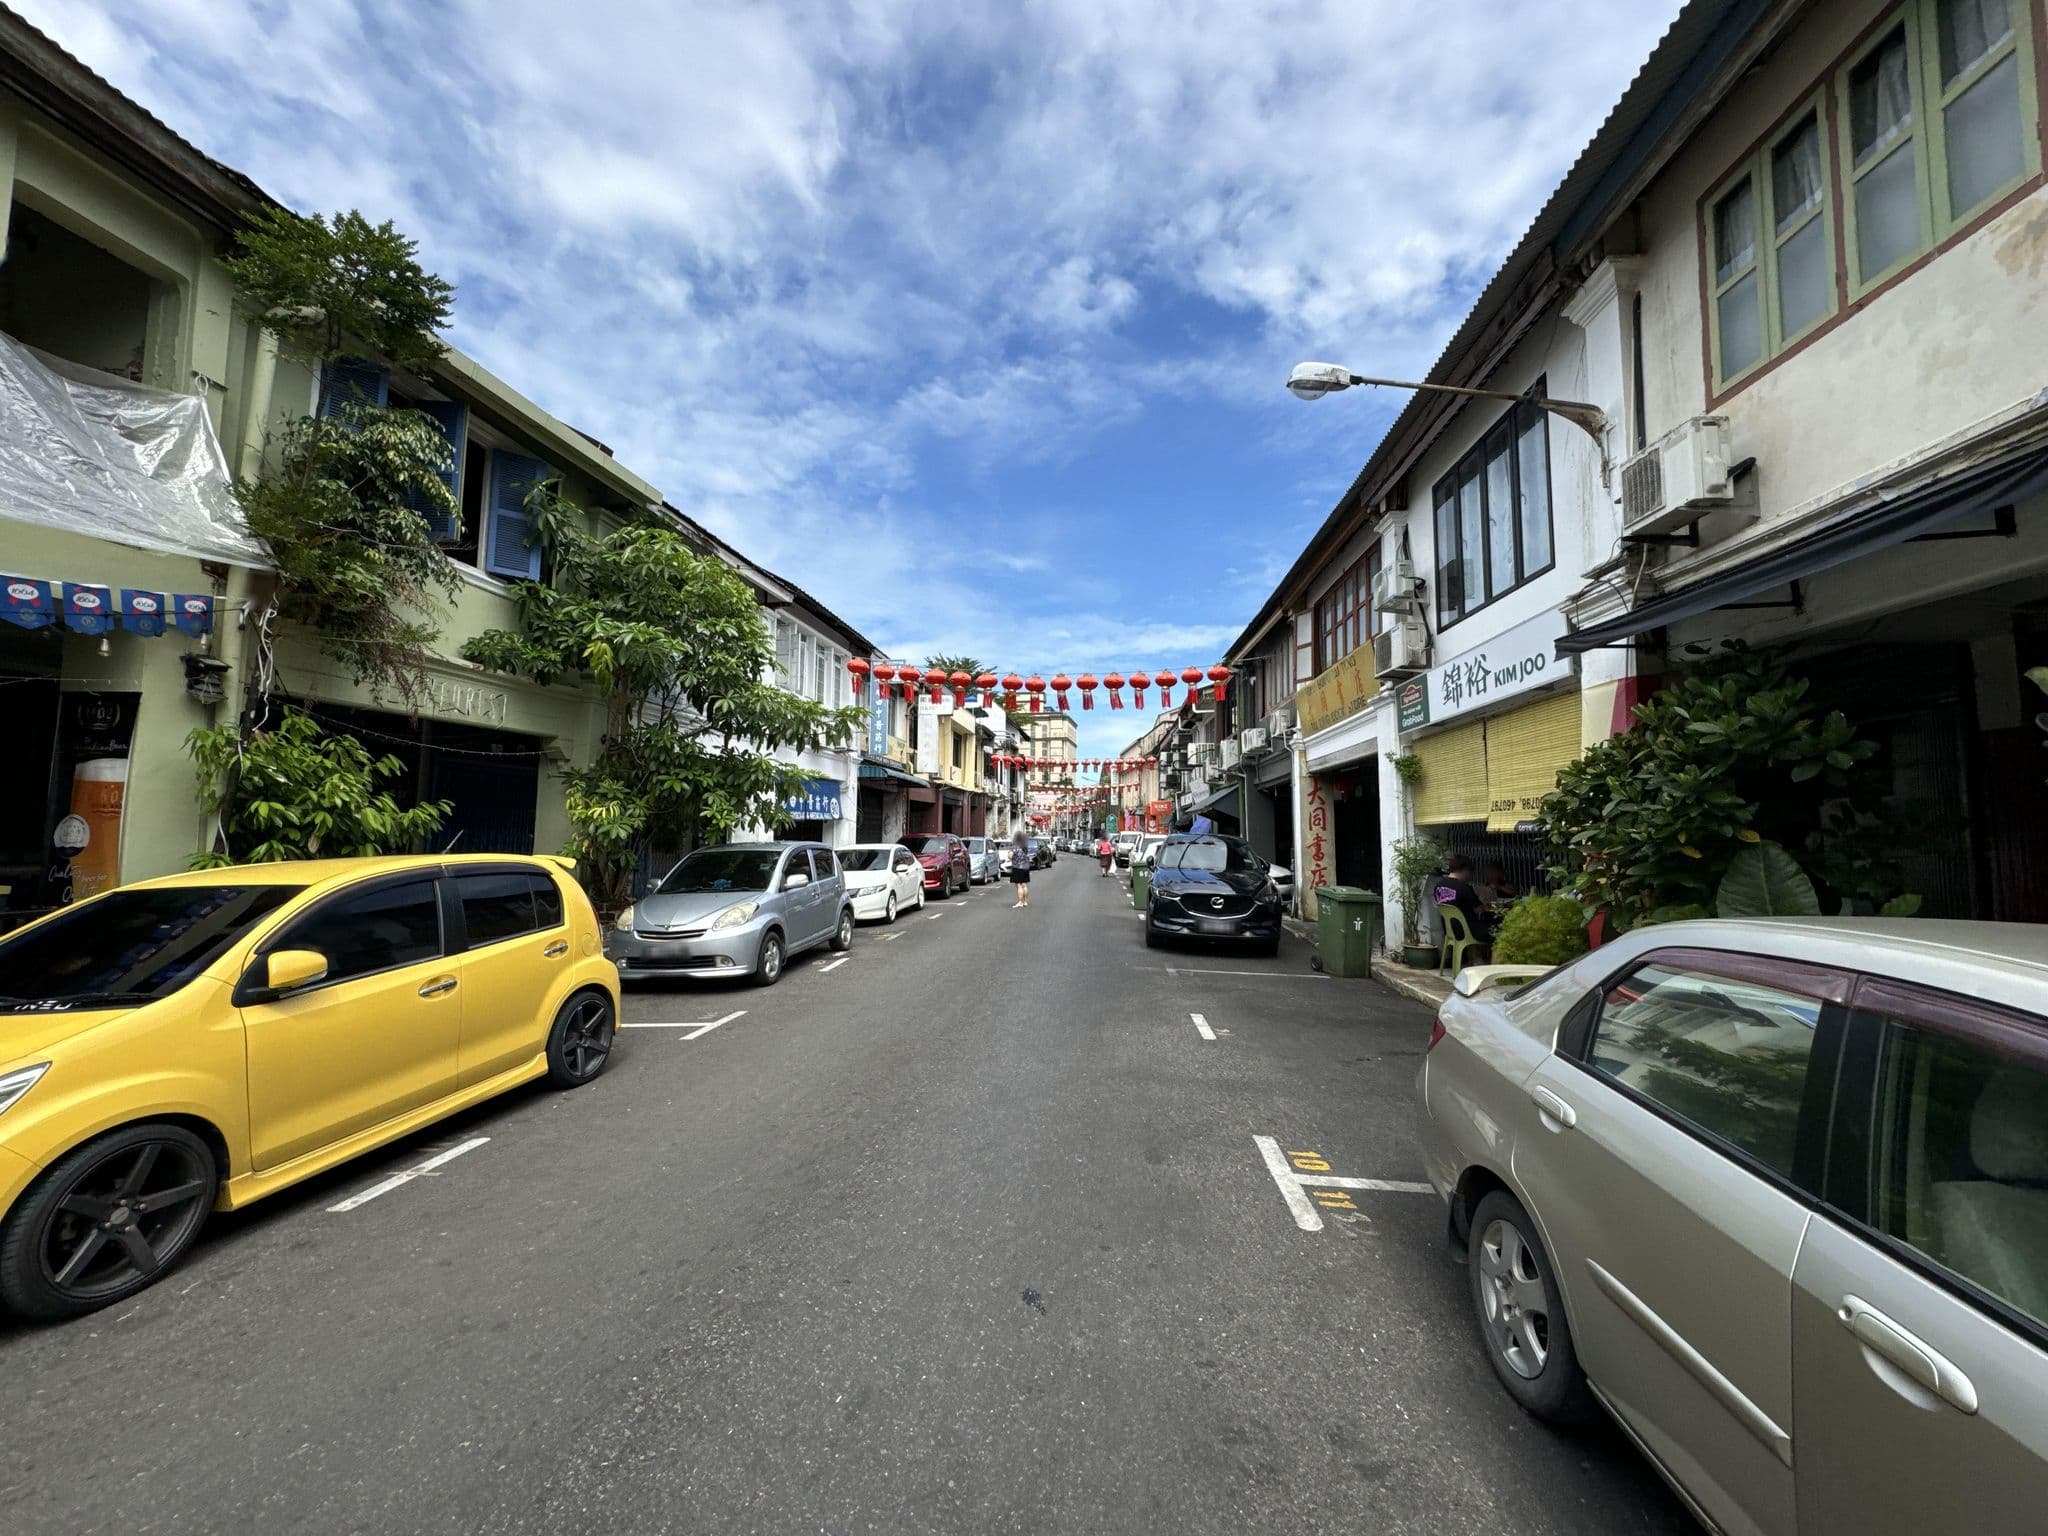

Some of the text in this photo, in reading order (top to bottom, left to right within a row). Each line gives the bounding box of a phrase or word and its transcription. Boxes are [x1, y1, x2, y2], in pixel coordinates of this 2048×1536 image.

[1442, 654, 1492, 709] 錦裕
[1494, 653, 1546, 688] KIM JOO
[1306, 774, 1328, 891] 大同書店
